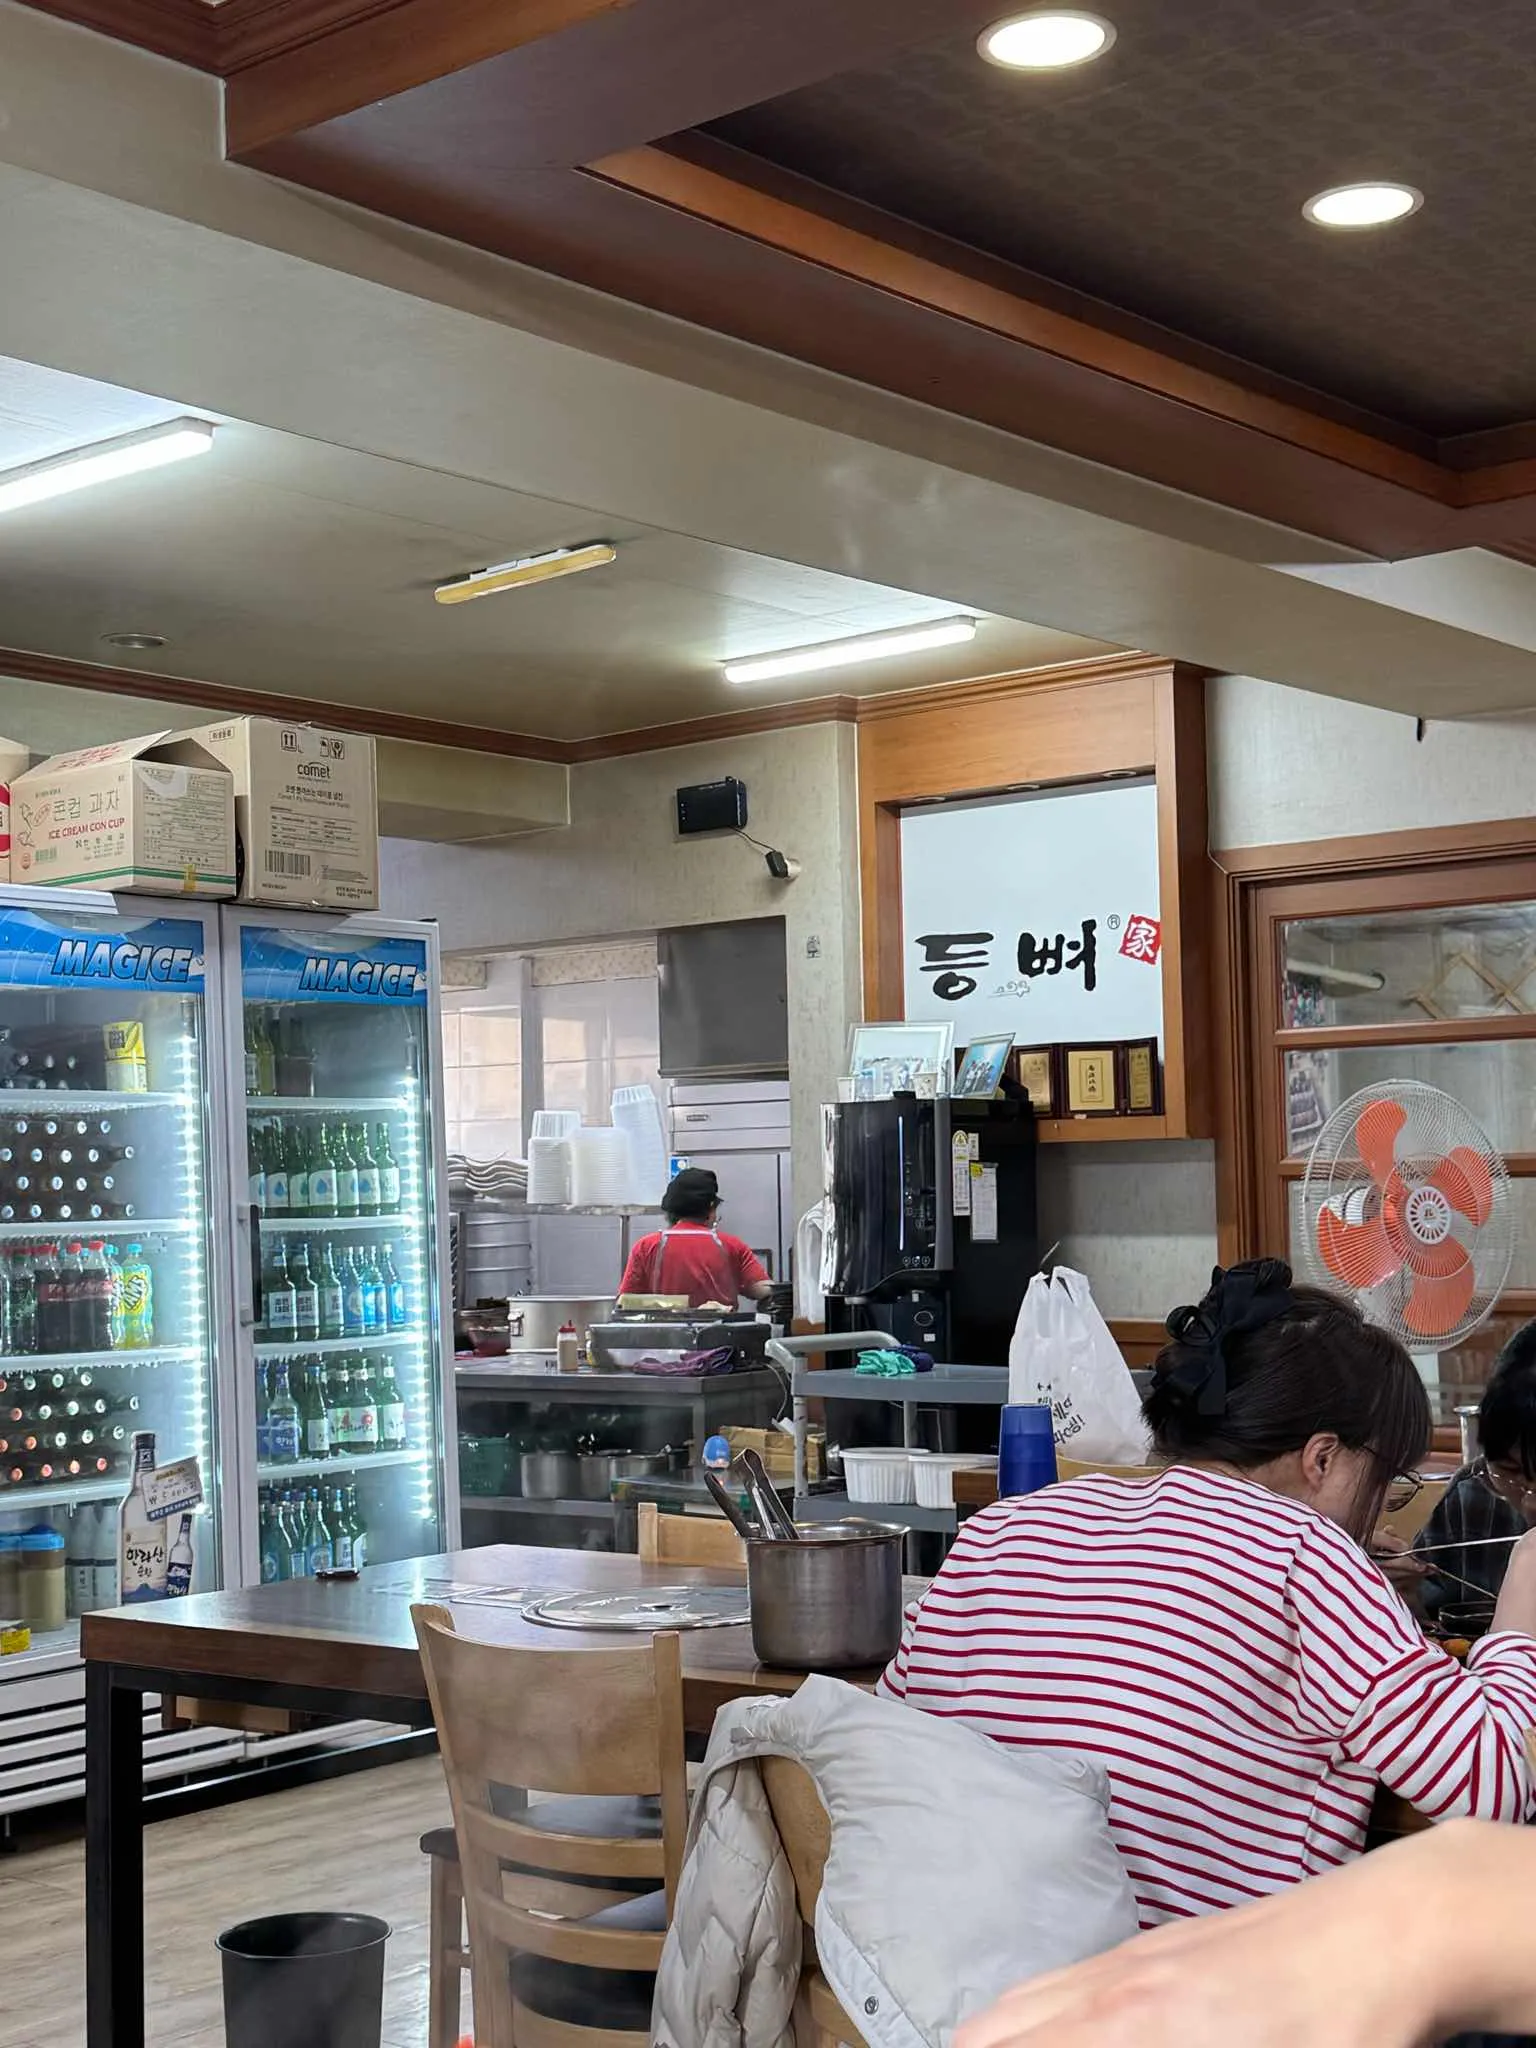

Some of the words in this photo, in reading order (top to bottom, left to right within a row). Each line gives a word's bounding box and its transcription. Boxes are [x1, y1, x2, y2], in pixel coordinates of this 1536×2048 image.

[297, 761, 331, 779] comet
[53, 796, 81, 822] 콘컵
[89, 788, 120, 815] 과자
[48, 829, 62, 840] ICE
[62, 823, 89, 839] CREAM
[89, 821, 108, 833] CON
[108, 817, 125, 829] CUP
[1122, 918, 1158, 962] 家
[51, 939, 194, 983] MAGICE
[298, 957, 416, 997] MAGICE
[126, 1546, 165, 1567] 한라산
